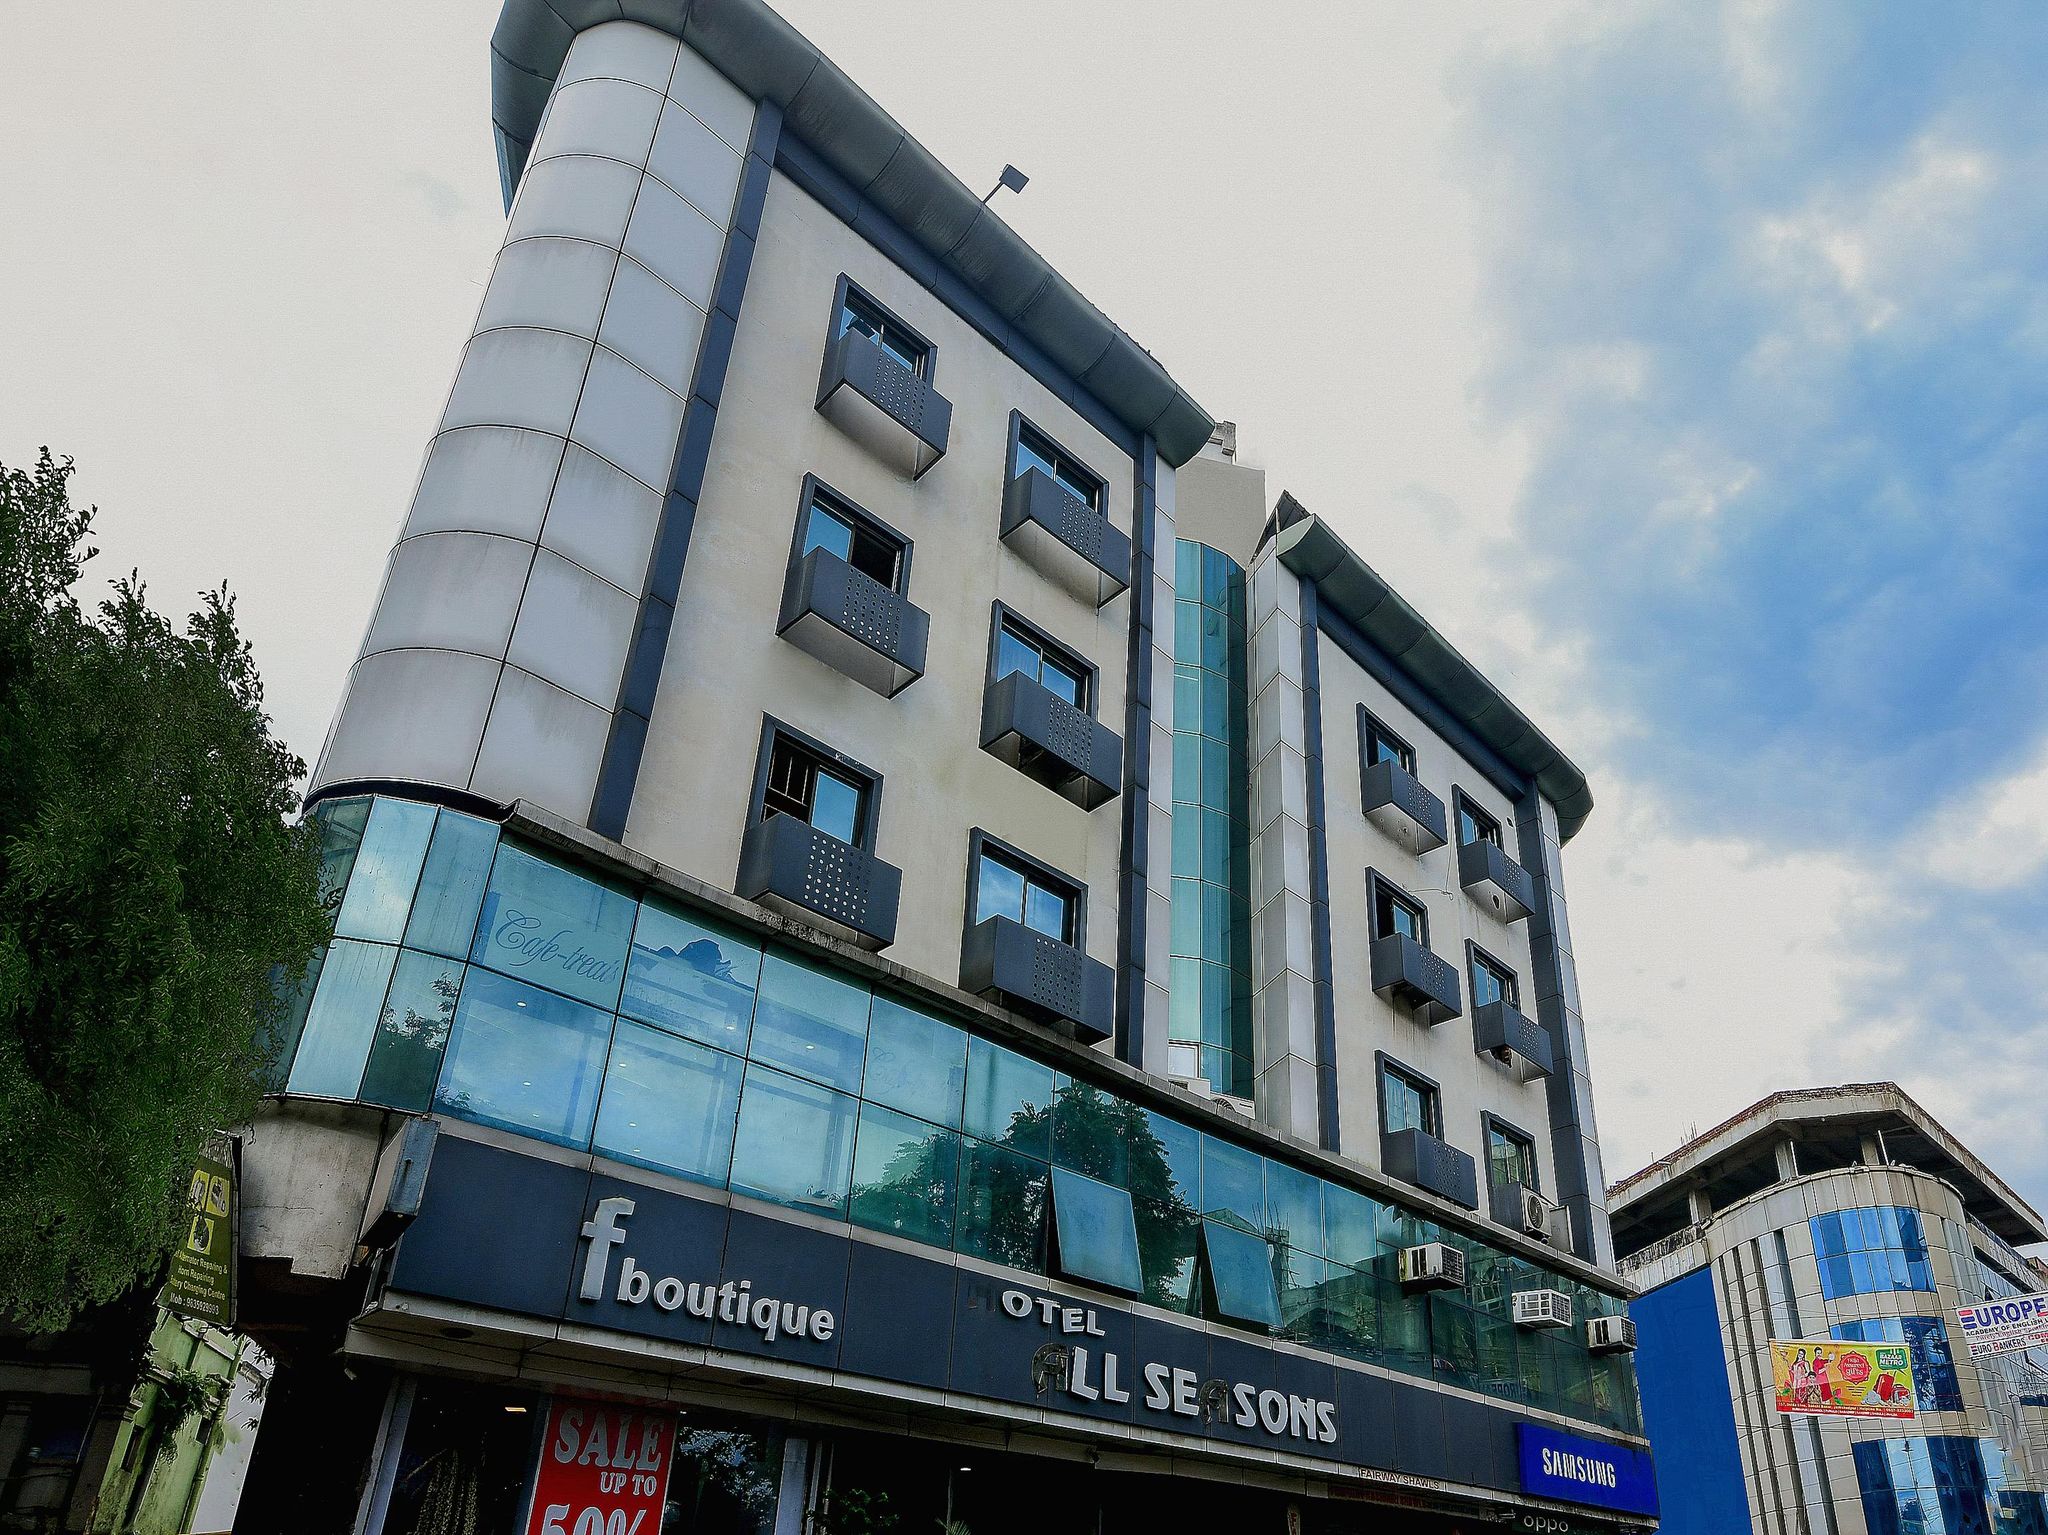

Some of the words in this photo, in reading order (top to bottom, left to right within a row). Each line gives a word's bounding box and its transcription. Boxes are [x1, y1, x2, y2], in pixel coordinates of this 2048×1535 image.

[580, 1197, 636, 1300] f
[617, 1257, 835, 1342] boutique
[208, 1288, 226, 1301] Centre
[1966, 1326, 1999, 1337] ACADEMY
[1993, 1337, 2027, 1352] BANKERS
[1880, 1358, 1904, 1366] METRO
[1032, 1342, 1130, 1403] ALL
[1144, 1362, 1337, 1443] SEASONS
[555, 1407, 664, 1472] SALE
[1542, 1447, 1616, 1488] SAMSUNG
[600, 1471, 627, 1494] UP
[632, 1474, 657, 1497] TO
[1361, 1469, 1401, 1483] FAIRWAY
[1403, 1476, 1439, 1489] SHAWLS
[1524, 1515, 1569, 1533] oppo
